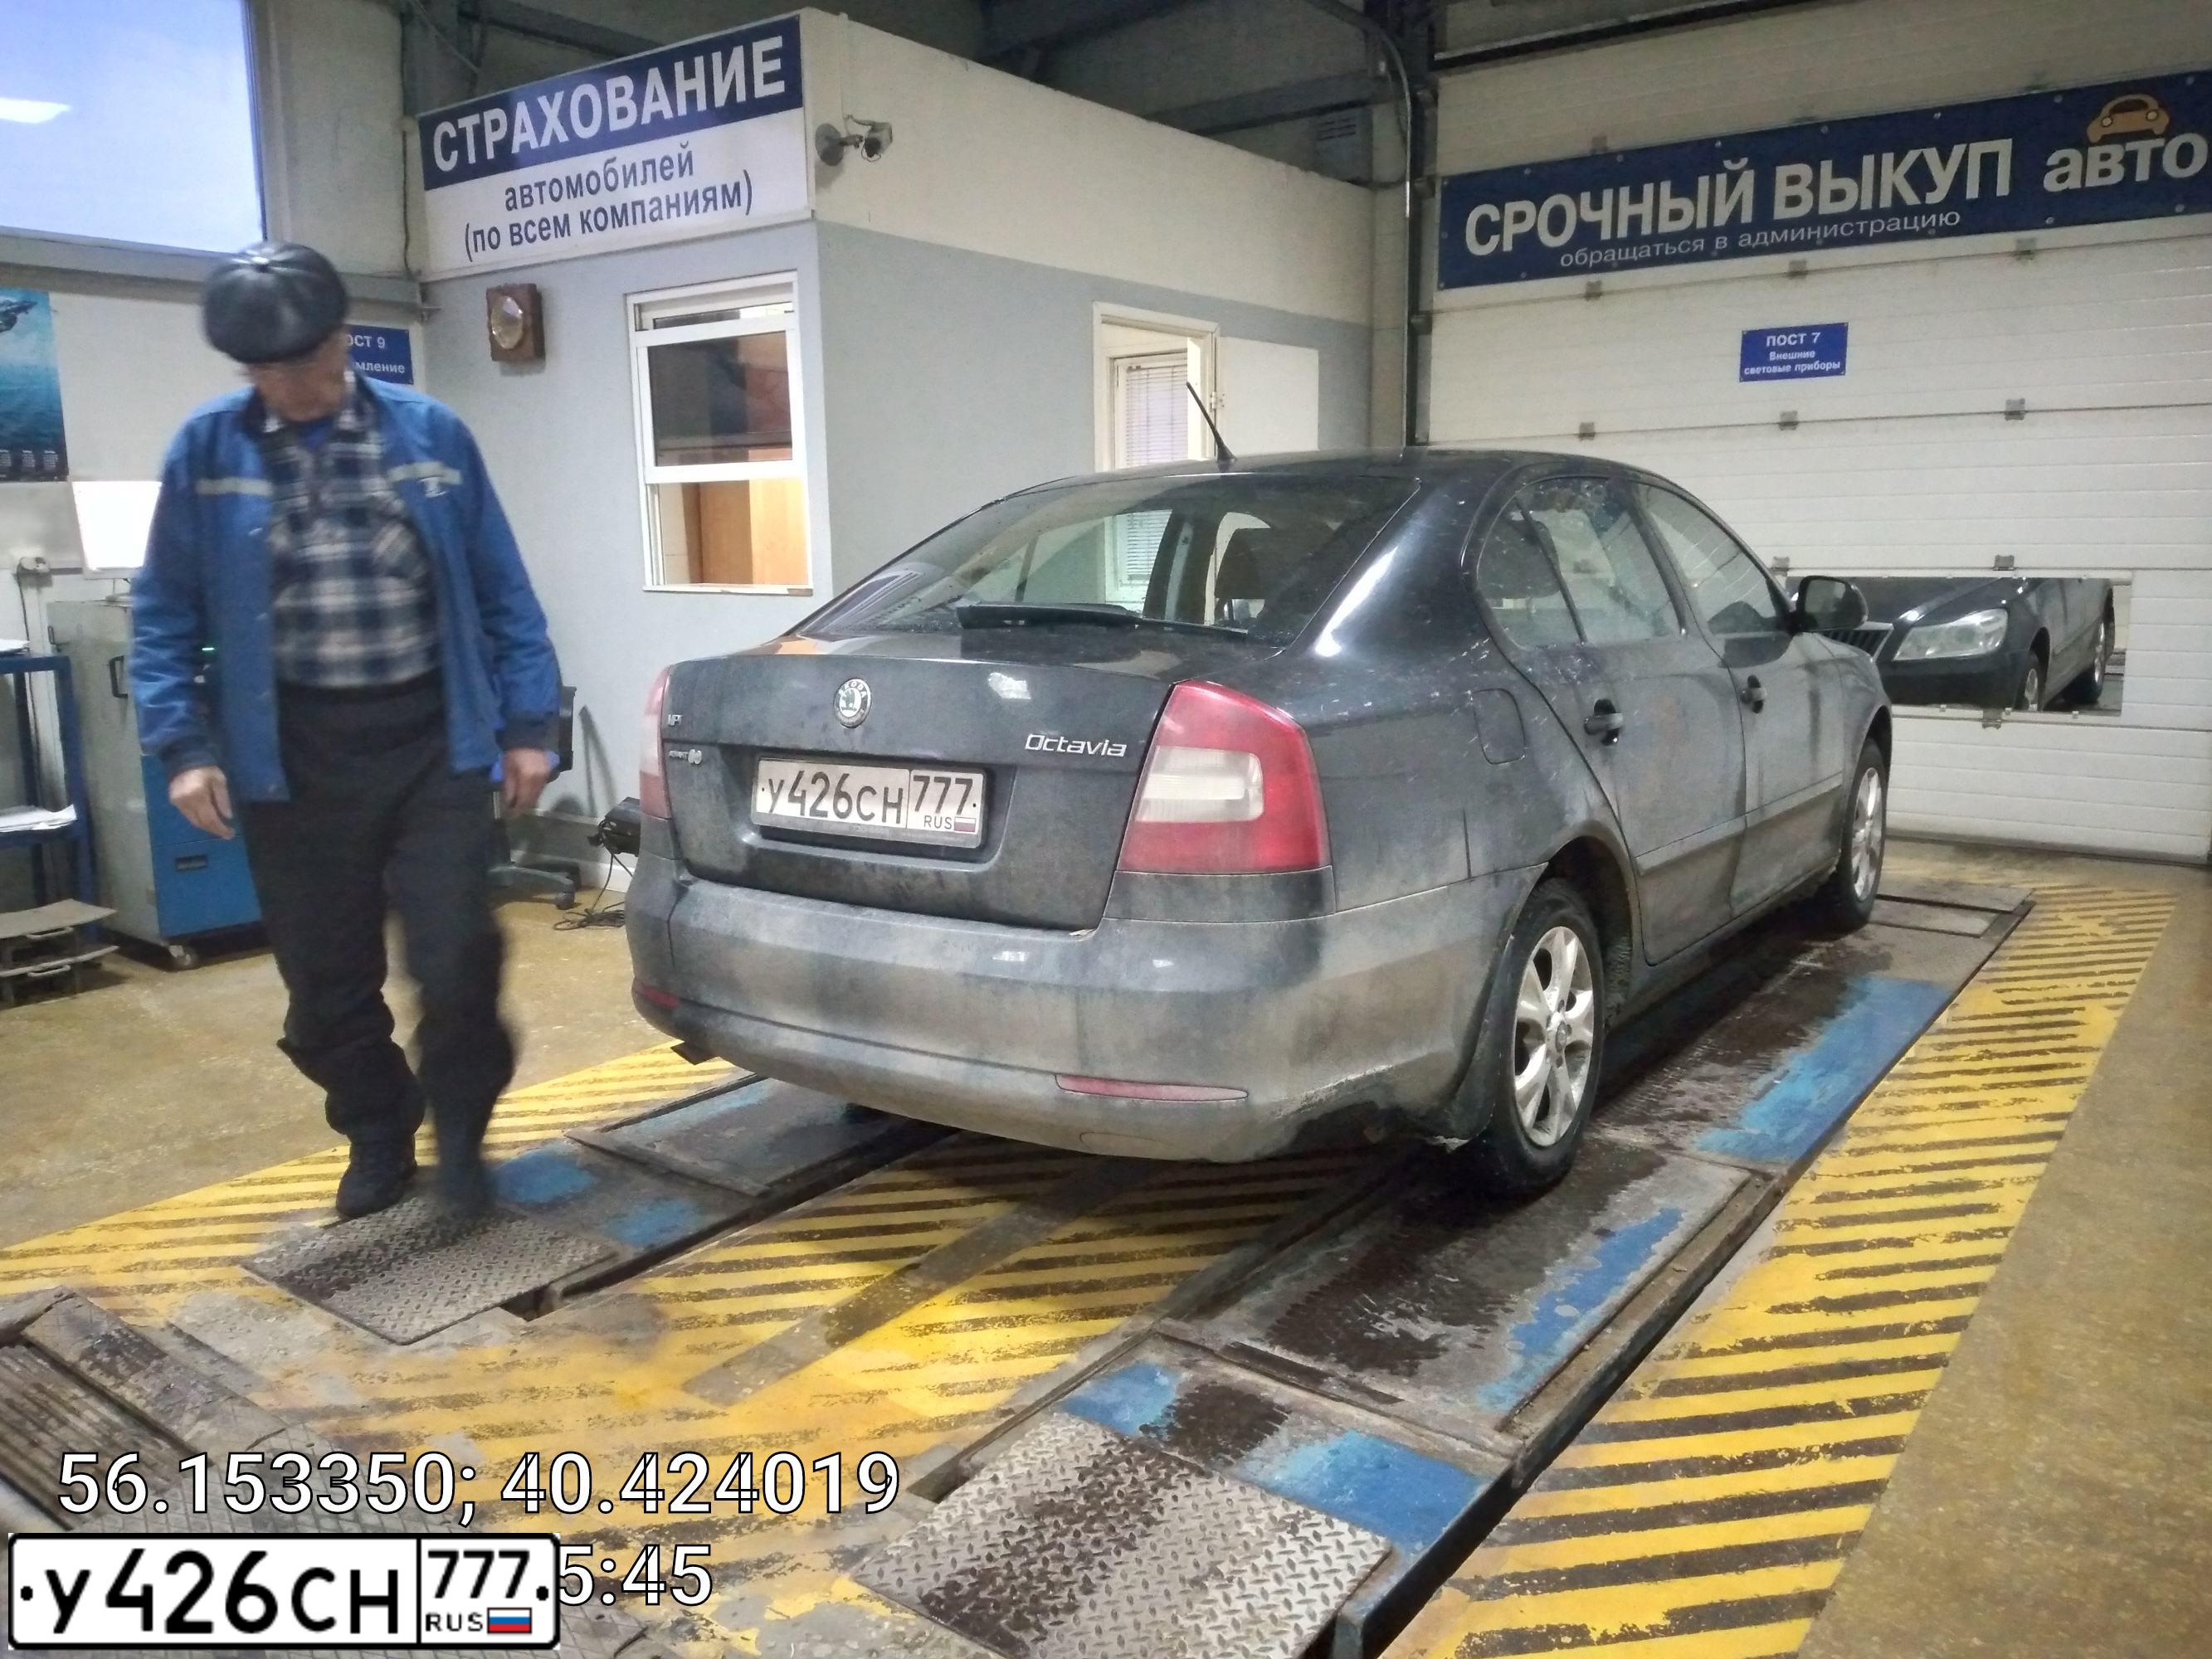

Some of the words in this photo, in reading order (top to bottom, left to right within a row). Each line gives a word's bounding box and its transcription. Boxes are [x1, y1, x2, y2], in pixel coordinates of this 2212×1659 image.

[432, 35, 786, 172] СТРАХОВАНИЕ
[504, 140, 694, 212] автомобилей
[1465, 157, 1755, 256] СРОЧНЫЙ
[1773, 138, 2013, 221] ВЫКУП
[2043, 132, 2209, 193] авто
[465, 223, 500, 261] (по
[509, 212, 571, 246] всем
[579, 169, 753, 234] компаниям)
[1560, 237, 1704, 267] обращаться
[1715, 236, 1727, 250] в
[1738, 211, 1961, 249] администрацию
[345, 333, 372, 348] ОСТ
[377, 336, 386, 348] 9
[1766, 333, 1807, 347] ПОСТ
[1811, 332, 1821, 344] 7
[354, 362, 405, 373] мление
[1744, 364, 1792, 374] световые
[1794, 360, 1840, 372] приборы
[1769, 350, 1815, 361] Внешние
[1024, 733, 1127, 757] Octavia
[913, 775, 973, 815] 777
[923, 815, 953, 830] RUS
